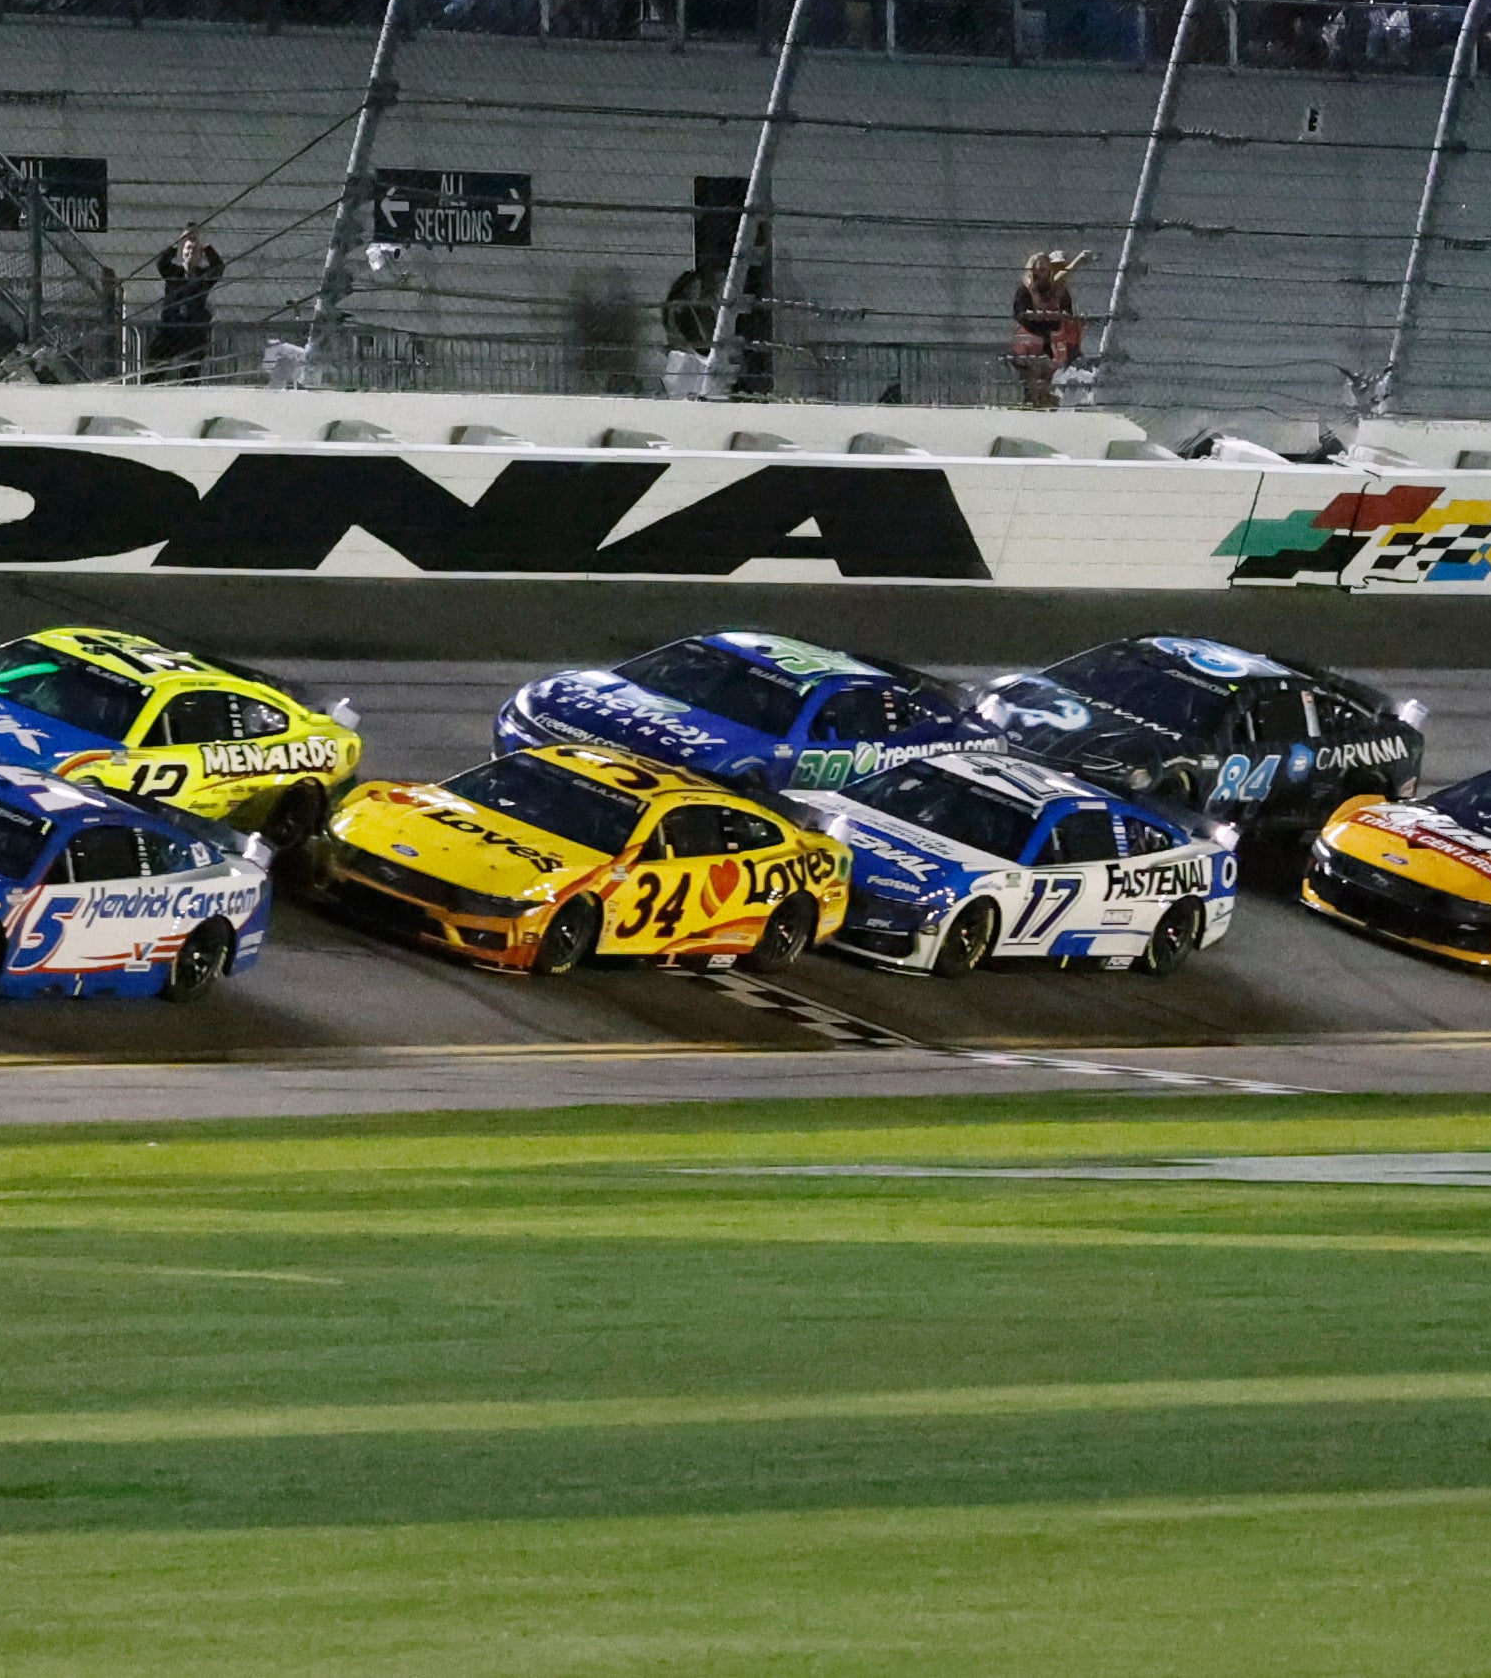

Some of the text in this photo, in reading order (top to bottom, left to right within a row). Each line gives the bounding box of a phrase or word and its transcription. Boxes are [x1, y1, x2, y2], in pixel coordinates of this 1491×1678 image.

[438, 173, 467, 208] ALL
[416, 209, 492, 243] SECTIONS
[200, 738, 339, 777] MENARDS
[1316, 735, 1408, 771] CARVANA
[129, 763, 189, 798] 12
[1209, 753, 1282, 802] 84
[1103, 857, 1211, 902] FASTENAL
[615, 873, 692, 938] 34
[1003, 874, 1085, 944] 17
[8, 893, 85, 973] 5
